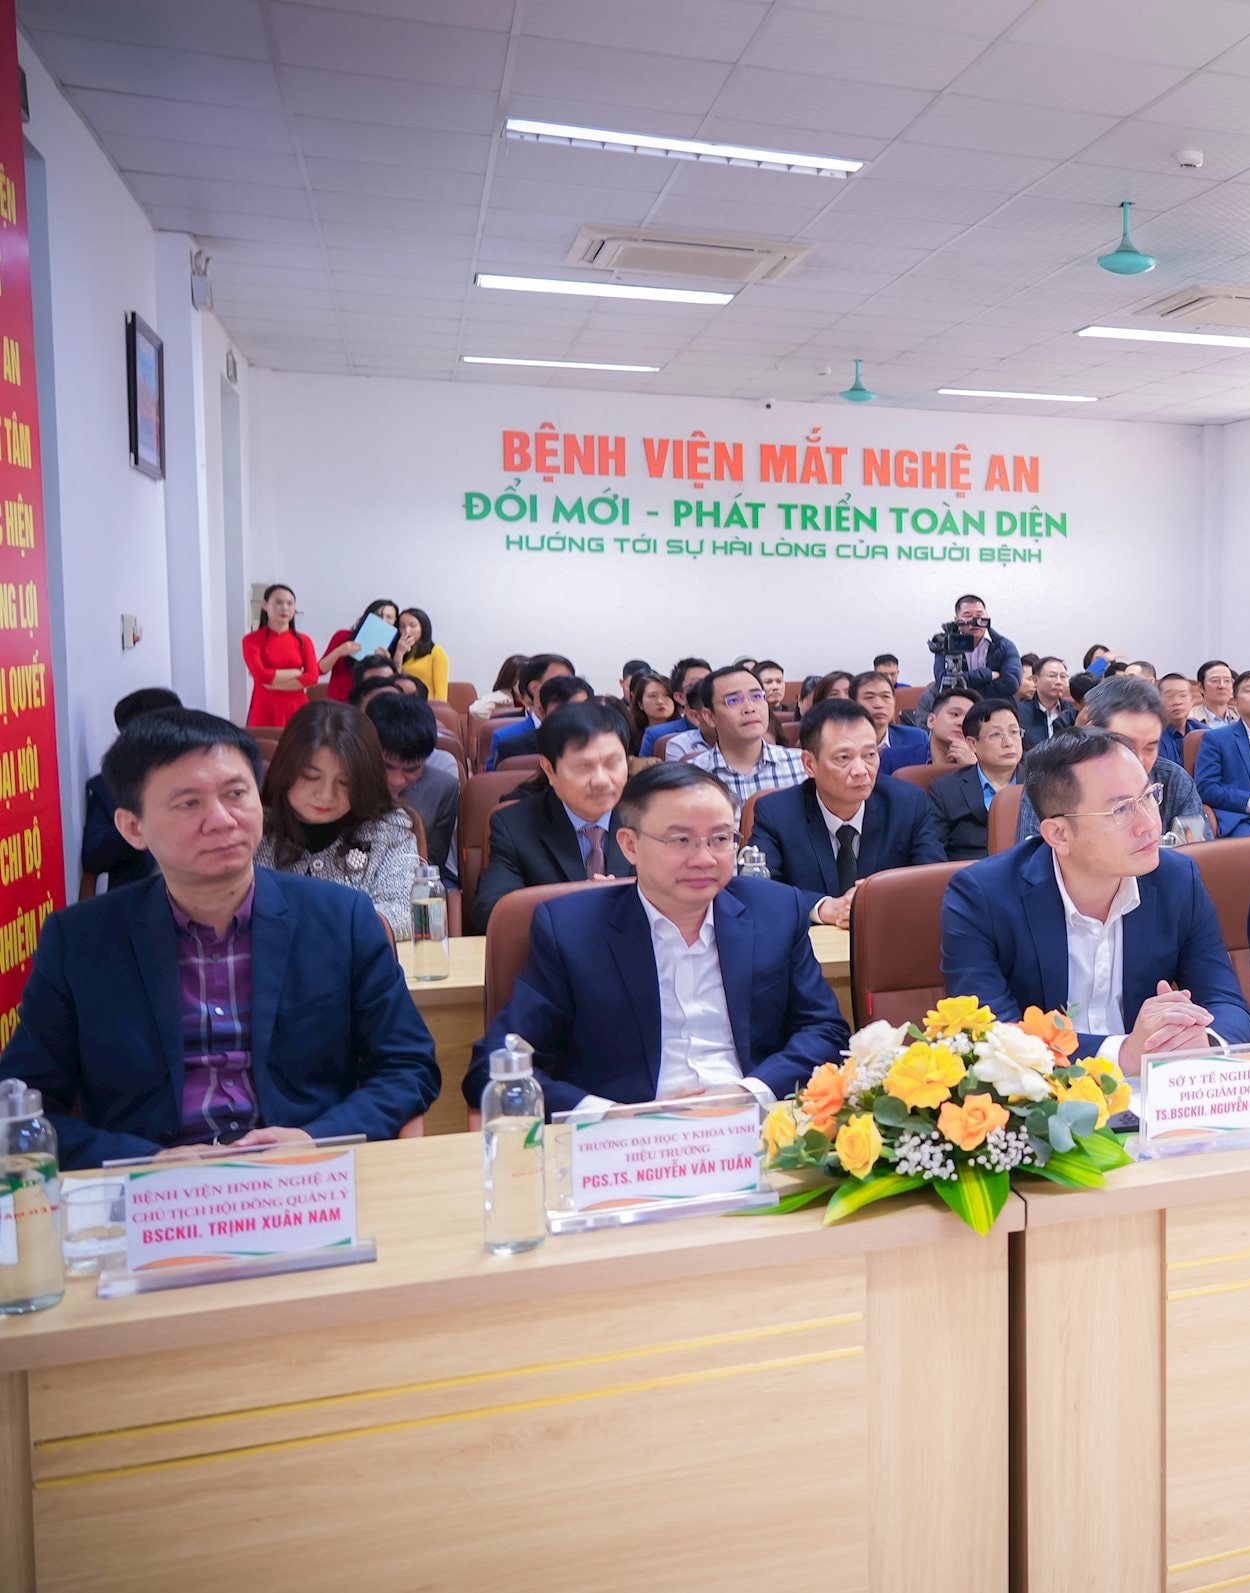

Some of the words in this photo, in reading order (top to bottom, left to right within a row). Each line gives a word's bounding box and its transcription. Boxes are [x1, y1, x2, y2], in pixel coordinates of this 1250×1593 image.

[3, 336, 21, 386] AN
[5, 411, 32, 468] TÂM
[502, 422, 626, 482] BỆNH
[643, 430, 744, 489] VIỆN
[760, 427, 848, 485] MẮT
[863, 443, 972, 498] NGHỆ
[984, 454, 1040, 493] AN
[5, 494, 35, 558] HIỆN
[462, 478, 538, 523] ĐỔI
[552, 488, 630, 525] MỚI
[673, 492, 766, 529] PHÁT
[777, 493, 877, 532] TRIỂN
[889, 502, 986, 536] TOÀN
[996, 505, 1068, 543] DIỆN
[505, 531, 605, 552] HƯỚNG
[613, 533, 657, 553] TỚI
[666, 538, 705, 559] SỰ
[712, 536, 753, 555] HÀI
[760, 538, 826, 557] LÒNG
[835, 539, 888, 559] CỦA
[897, 542, 970, 562] NGƯỜI
[979, 544, 1042, 566] BỆNH
[19, 580, 38, 638] LỢI
[9, 650, 46, 717] QUYẾT
[17, 736, 39, 801] HỘI
[0, 832, 22, 887] CHI
[24, 815, 42, 880] BỘ
[1168, 1075, 1186, 1087] SỞ
[1189, 1075, 1196, 1085] Y
[1200, 1071, 1216, 1084] TẾ
[1180, 1088, 1204, 1102] PHÓ
[1206, 1086, 1237, 1099] GIÁM
[1155, 1105, 1207, 1121] TS.BSCKII.
[1210, 1096, 1248, 1115] NGUYỄN
[578, 1138, 628, 1152] TRƯỜNG
[682, 1132, 689, 1140] Y
[692, 1127, 725, 1139] KHOA
[728, 1124, 755, 1135] VINH
[132, 1190, 178, 1205] BỆNH
[183, 1183, 222, 1198] VIỆN
[278, 1172, 322, 1187] NGHỆ
[327, 1171, 348, 1183] AN
[582, 1171, 632, 1189] PGS.TS.
[637, 1159, 686, 1182] NGUYỄN
[692, 1159, 715, 1175] VĂN
[143, 1224, 203, 1244] BSCKII.
[208, 1218, 256, 1237] TRỊNH
[262, 1209, 302, 1230] XUÂN
[308, 1207, 340, 1224] NAM
[168, 1206, 206, 1220] TỊCH
[209, 1200, 236, 1215] HỘI
